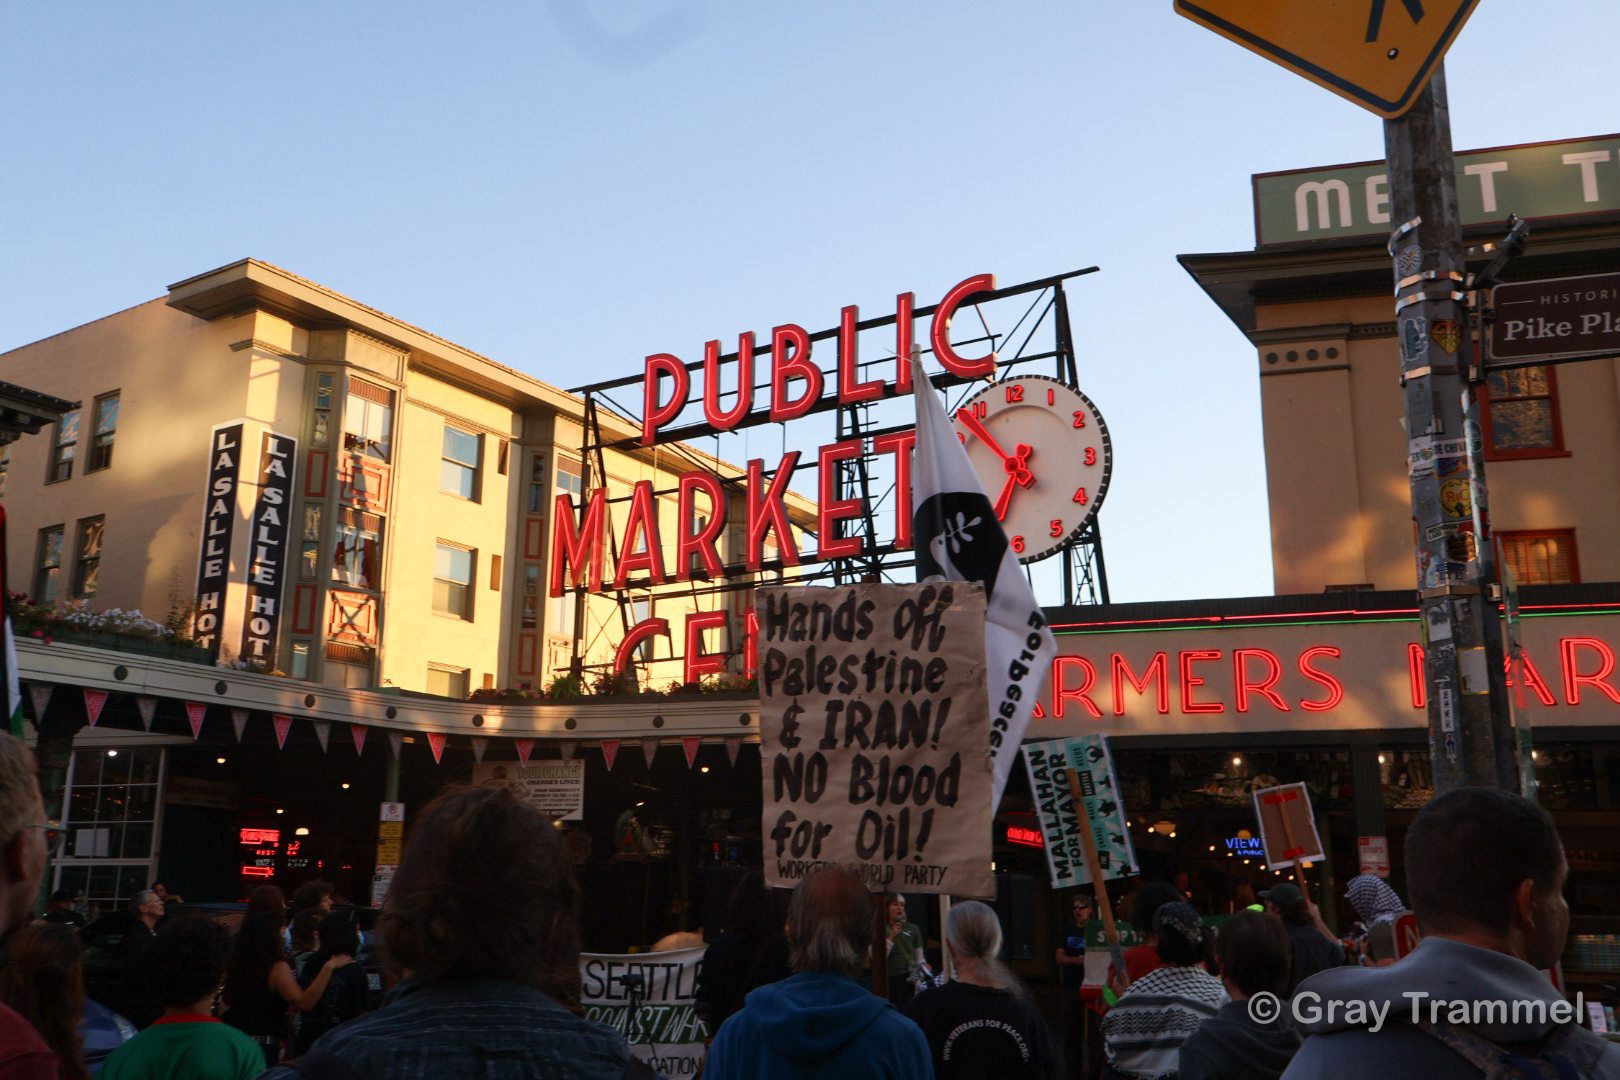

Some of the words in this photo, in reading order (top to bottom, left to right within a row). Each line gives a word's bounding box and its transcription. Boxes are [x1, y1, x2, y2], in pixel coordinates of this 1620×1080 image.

[1294, 161, 1508, 232] MET
[1541, 289, 1617, 305] HISTORI
[1504, 317, 1573, 341] Pike
[642, 273, 997, 446] PUBLIC
[972, 401, 987, 418] 11
[1005, 385, 1024, 403] 12
[1047, 389, 1054, 405] 1
[1073, 411, 1085, 428] 2
[213, 433, 236, 471] LA
[263, 436, 288, 479] LA
[1083, 447, 1096, 465] 3
[550, 428, 916, 599] MARKET
[1072, 488, 1088, 505] 4
[203, 477, 233, 578] SALLE
[254, 487, 284, 586] SALLE
[1011, 536, 1024, 552] 6
[1050, 520, 1063, 536] 5
[766, 588, 876, 643] Hands
[893, 585, 954, 653] off
[764, 644, 948, 697] Palestine
[1034, 646, 1344, 719] RMERS
[779, 697, 806, 751] &
[818, 697, 952, 751] IRAN!
[773, 752, 828, 804] NO
[848, 752, 961, 808] Blood
[1048, 753, 1081, 835] MAYOR
[770, 809, 833, 860] for
[855, 806, 935, 862] Oil!
[1028, 750, 1072, 879] MALLAHAN
[1067, 837, 1083, 867] FOR
[904, 865, 948, 886] PARTY
